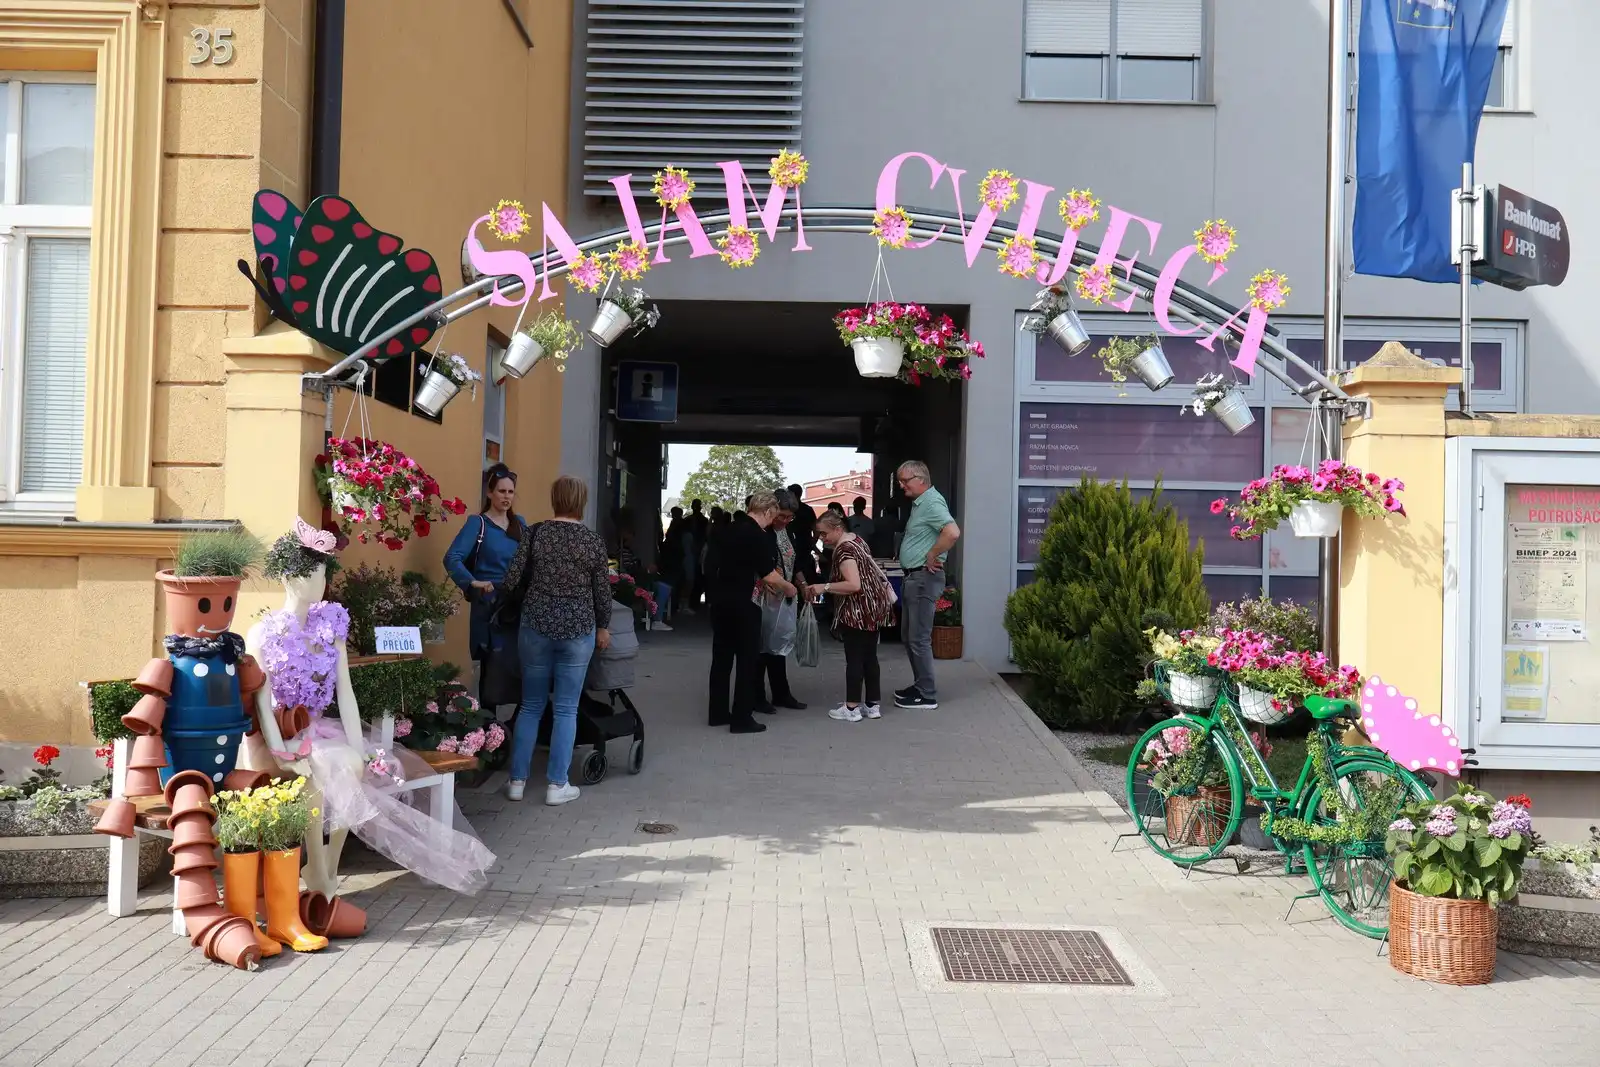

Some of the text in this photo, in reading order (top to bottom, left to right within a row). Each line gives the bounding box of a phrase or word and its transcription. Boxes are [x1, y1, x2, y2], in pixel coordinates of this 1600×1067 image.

[189, 27, 233, 64] 35
[1504, 199, 1561, 241] Bankomat
[1515, 237, 1536, 259] HPB
[1516, 549, 1549, 557] BIMEP
[383, 639, 414, 650] PRELOG
